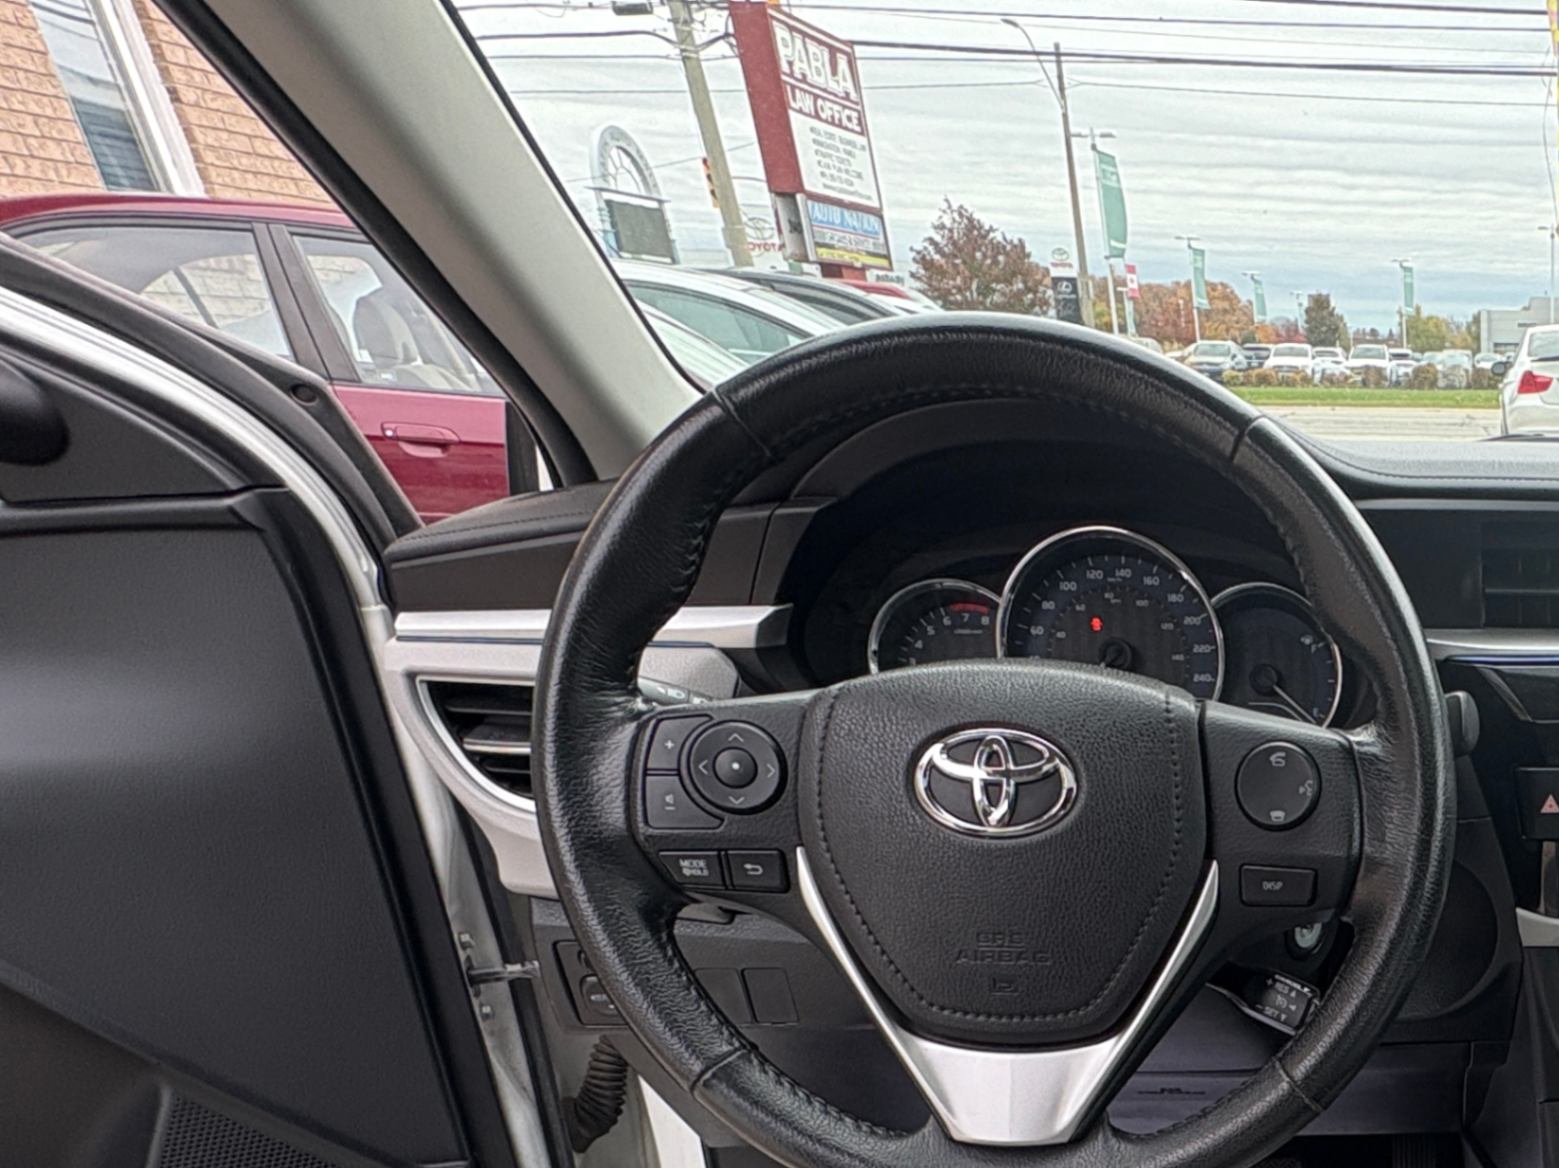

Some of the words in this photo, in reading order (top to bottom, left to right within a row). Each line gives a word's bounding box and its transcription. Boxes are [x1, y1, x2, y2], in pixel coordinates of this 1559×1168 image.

[772, 20, 861, 102] PABLA
[786, 85, 816, 116] LAW
[817, 98, 862, 132] OFFICE
[811, 202, 842, 226] AUTO
[746, 242, 785, 252] OYOTA
[1086, 569, 1104, 579] 120
[1115, 568, 1132, 578] 140
[1059, 581, 1077, 591] 100
[1143, 576, 1160, 586] 160
[1167, 593, 1184, 602] 180
[1041, 601, 1055, 610] 80
[943, 616, 951, 626] 6
[961, 613, 970, 622] 7
[981, 616, 990, 625] 8
[1184, 616, 1201, 625] 200
[926, 625, 935, 636] 5
[1030, 625, 1044, 635] 60
[914, 640, 923, 649] 4
[1193, 644, 1211, 653] 220
[1193, 673, 1212, 682] 240
[680, 859, 707, 868] MODE
[1262, 881, 1283, 891] DISP
[956, 949, 1051, 966] AIRBAG
